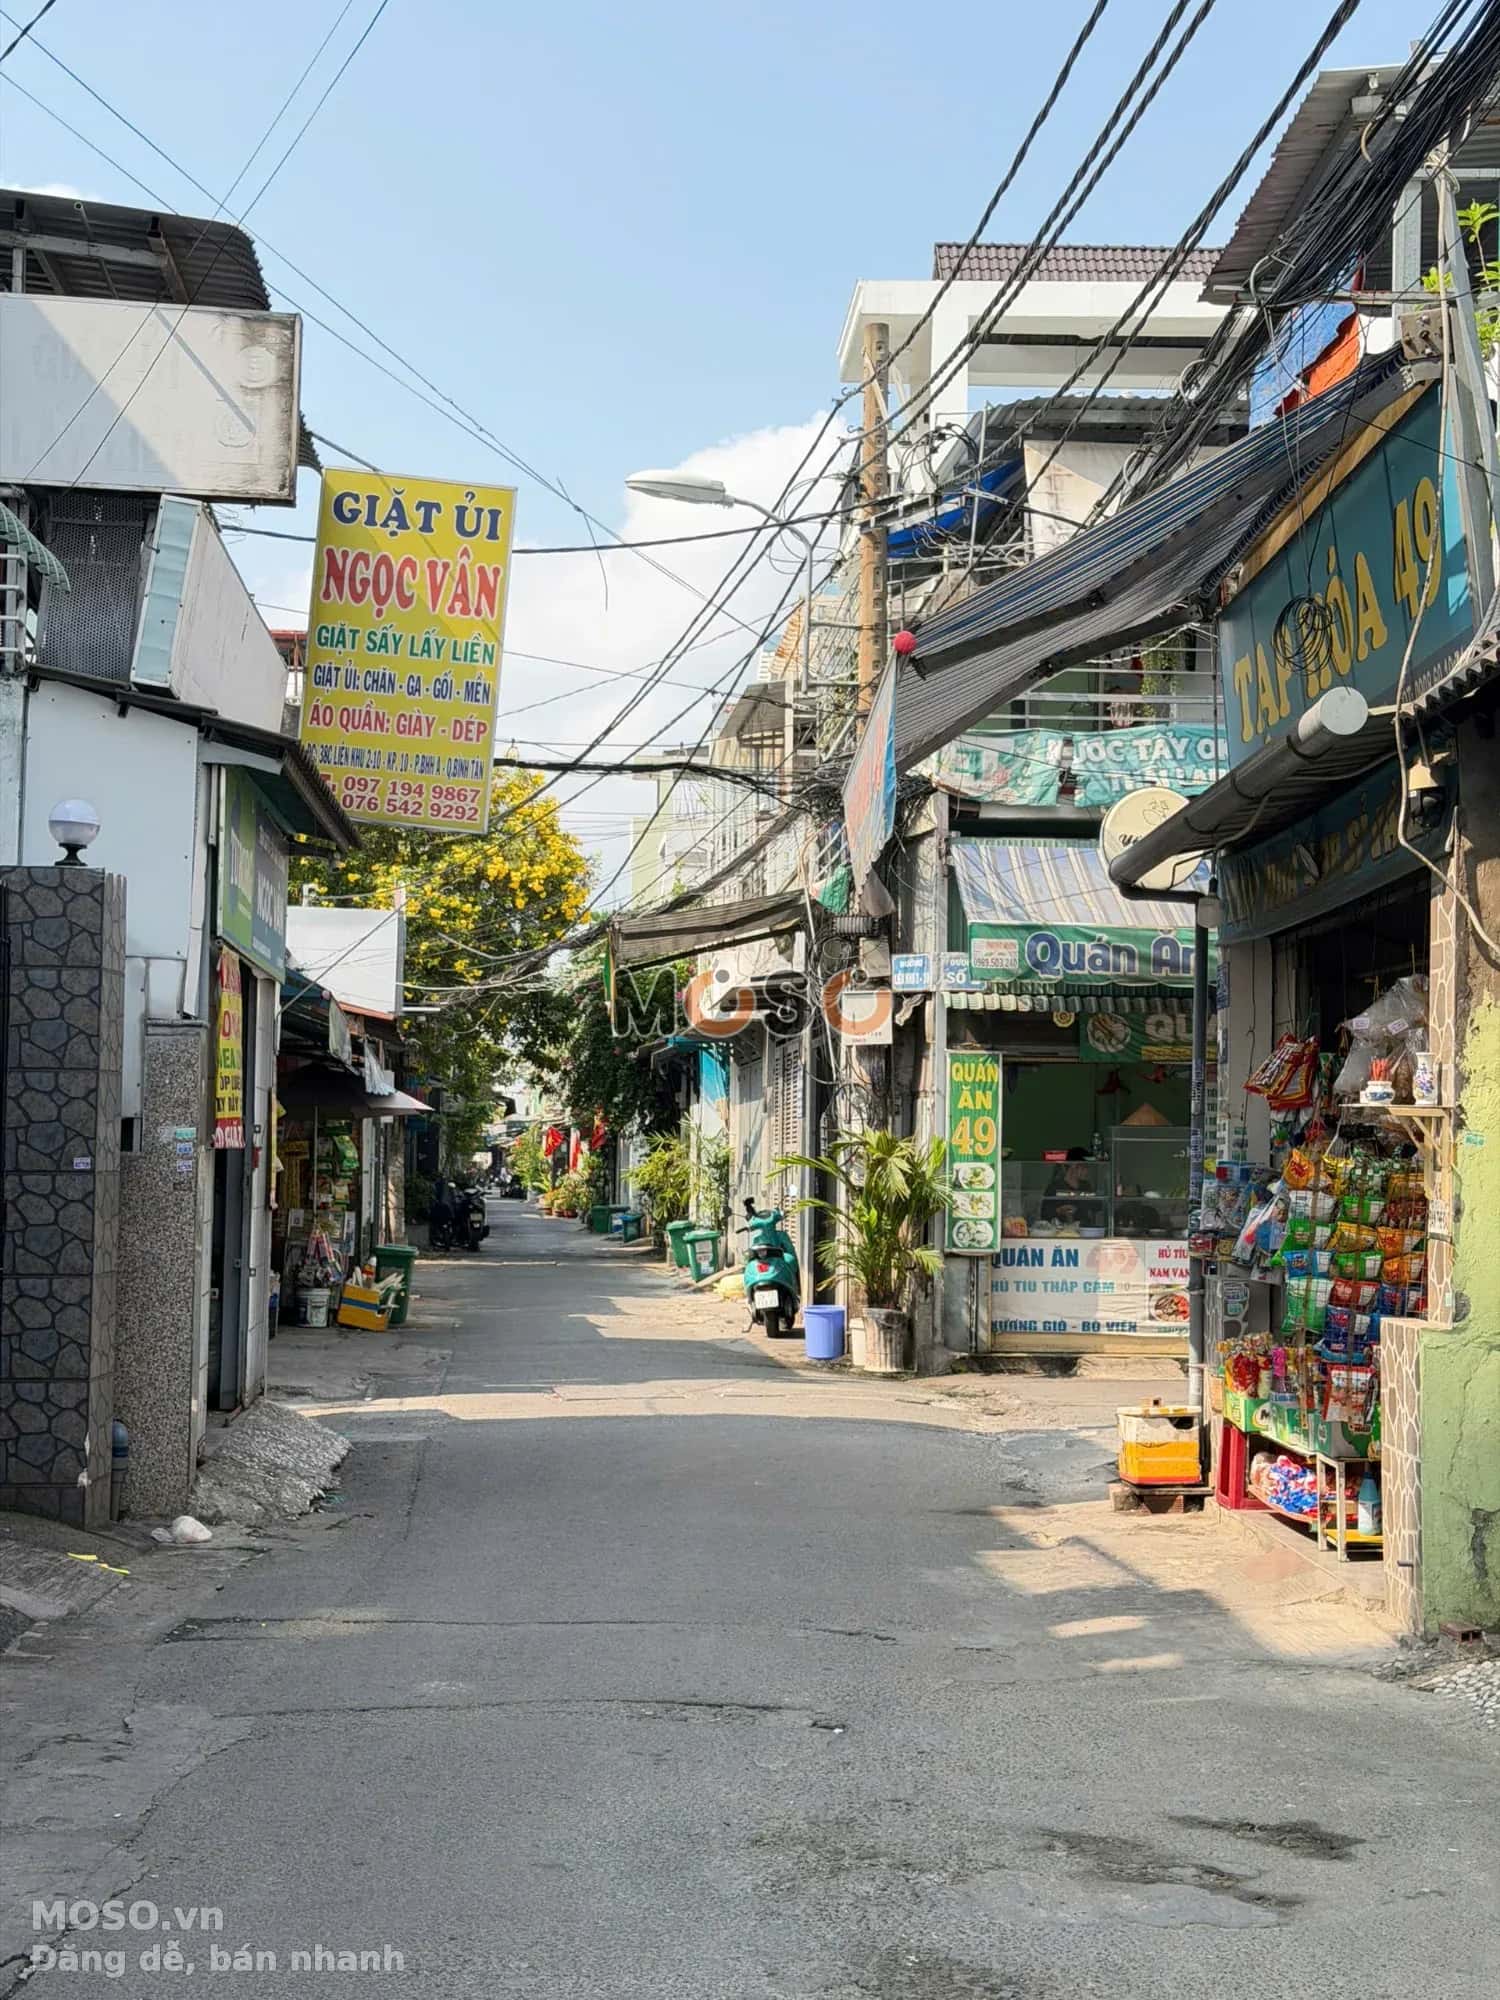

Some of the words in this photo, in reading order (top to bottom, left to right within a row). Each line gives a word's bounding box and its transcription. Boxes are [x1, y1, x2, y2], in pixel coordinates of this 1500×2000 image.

[333, 487, 442, 537] GIẶT
[455, 490, 502, 541] ỦI
[1394, 476, 1442, 620] 49
[322, 547, 418, 619] NGỌC
[426, 546, 501, 619] VÂN
[317, 623, 361, 656] GIẶT
[366, 623, 404, 655] SẤY
[409, 628, 447, 660] LẤY
[452, 632, 496, 666] LIỀN
[313, 662, 341, 693] GIẶT
[344, 659, 360, 690] ỦI:
[363, 667, 396, 695] CHĂN
[406, 674, 421, 697] GA
[433, 670, 453, 700] GỐI
[464, 672, 491, 705] MỀN
[309, 699, 334, 727] ÁO
[339, 700, 391, 733] QUẦN:
[396, 708, 436, 738] GIÀY
[452, 715, 488, 743] DÉP
[342, 793, 379, 812] 076
[386, 798, 423, 816] 542
[430, 802, 479, 822] 9292
[344, 775, 381, 795] 097
[390, 780, 425, 798] 194
[431, 785, 481, 803] 9867
[1026, 932, 1139, 979] Quán
[952, 1056, 999, 1082] QUÁN
[957, 1084, 993, 1110] ĂN
[951, 1116, 997, 1156] 49
[1051, 1244, 1079, 1267] ĂN
